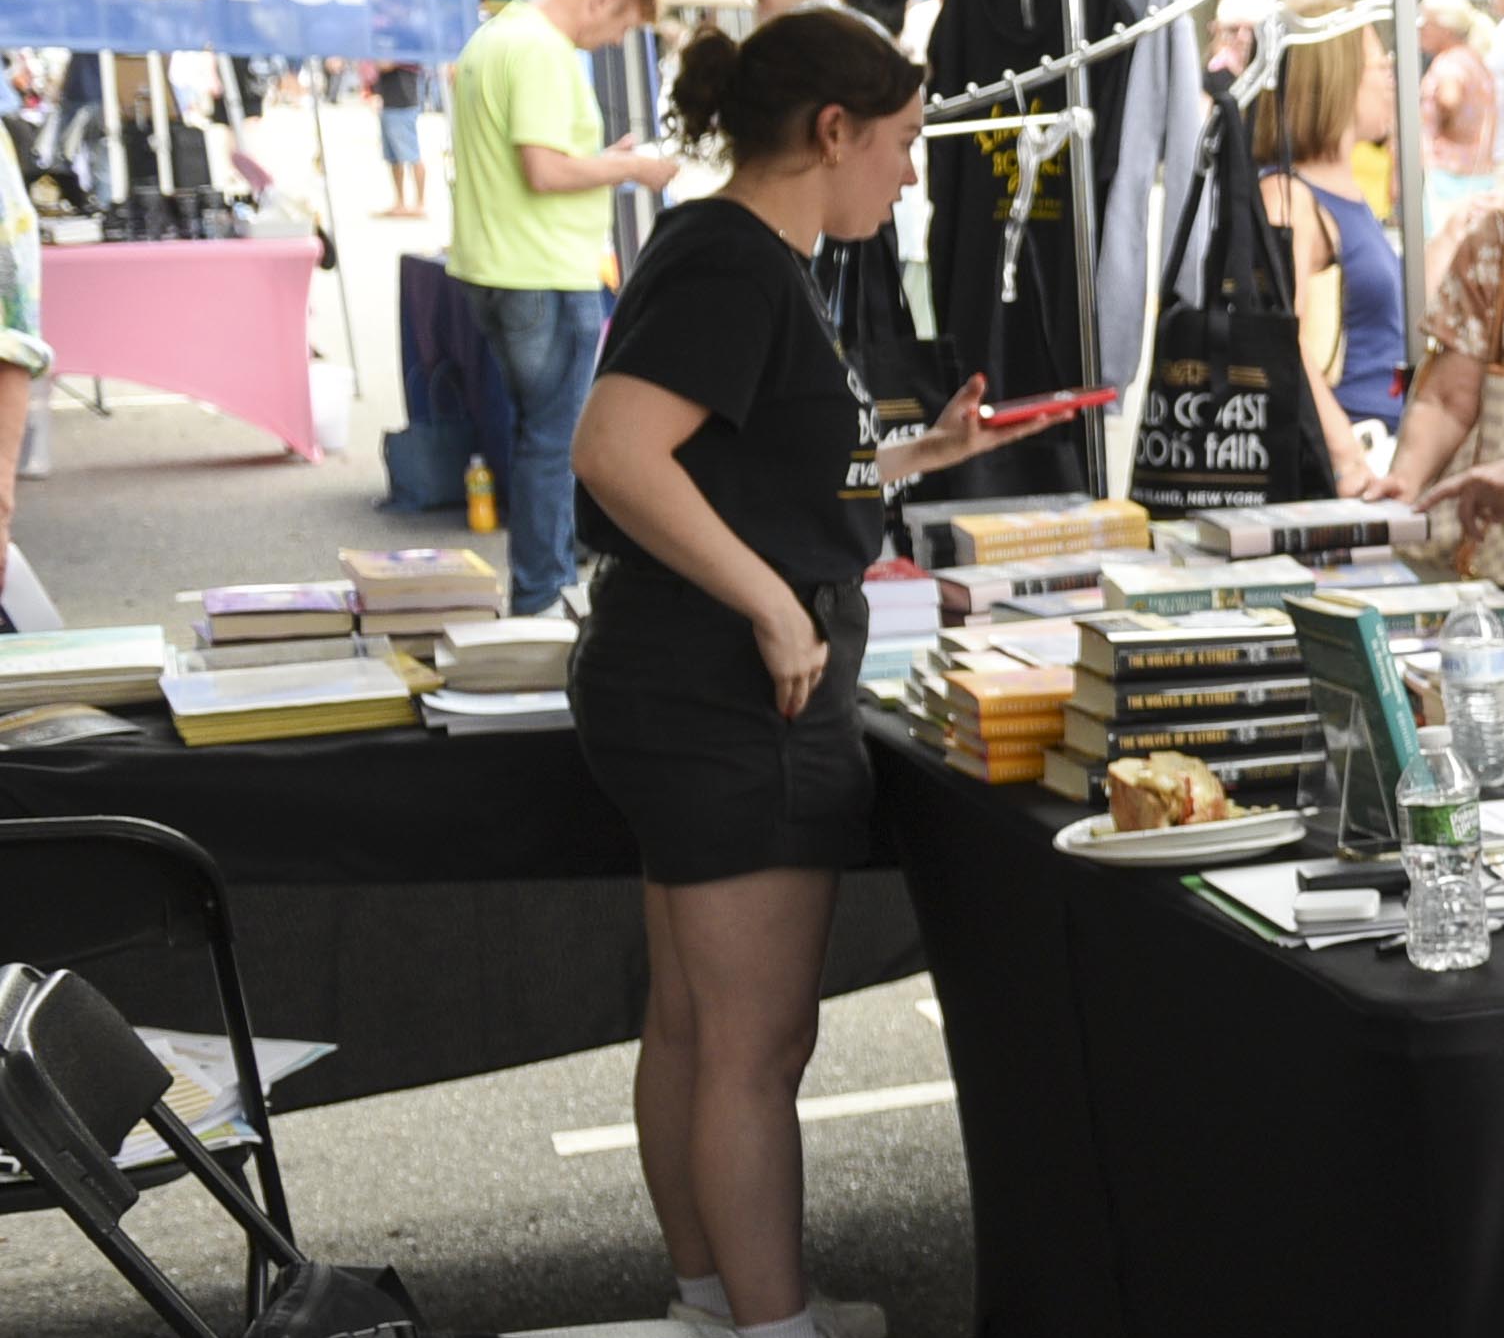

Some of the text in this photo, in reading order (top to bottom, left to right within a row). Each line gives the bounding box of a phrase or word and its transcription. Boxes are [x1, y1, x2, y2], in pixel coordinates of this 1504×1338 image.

[1205, 432, 1269, 469] FAIR
[1129, 655, 1144, 668] THE
[1146, 652, 1180, 666] WOLVES
[1184, 650, 1196, 663] OF
[1206, 649, 1239, 661] STREET
